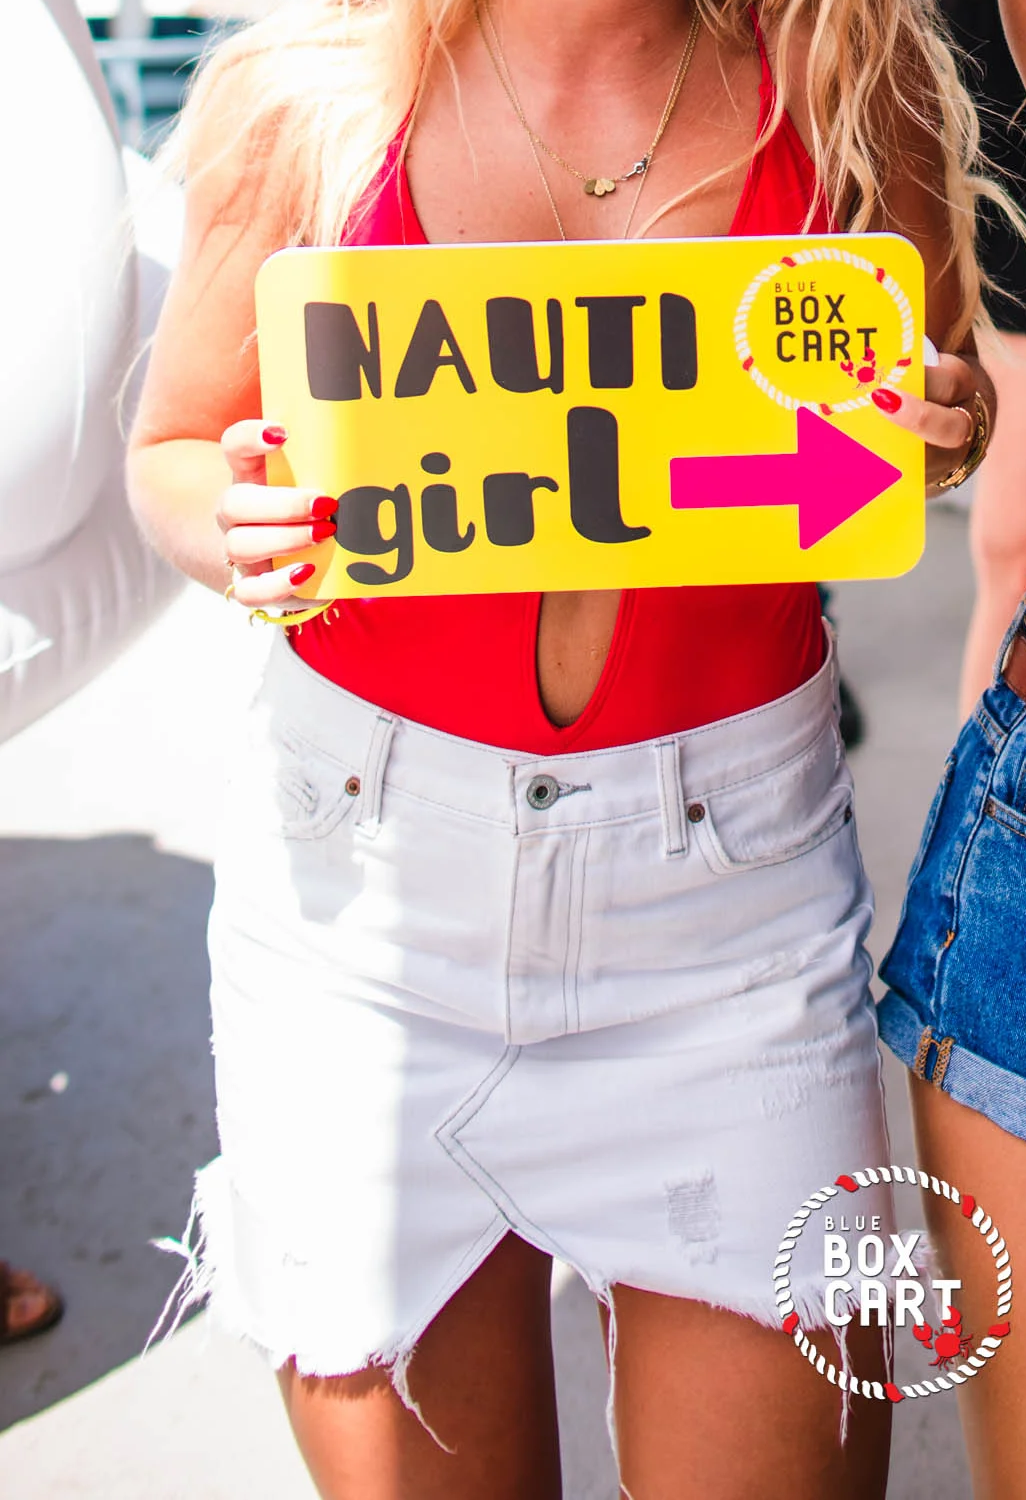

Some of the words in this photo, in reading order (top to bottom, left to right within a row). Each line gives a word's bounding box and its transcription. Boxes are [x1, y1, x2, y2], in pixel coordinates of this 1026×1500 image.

[775, 281, 816, 293] BLUE
[775, 294, 845, 326] BOX
[304, 293, 698, 401] NAUTI
[776, 327, 877, 363] CART
[331, 406, 651, 586] girl
